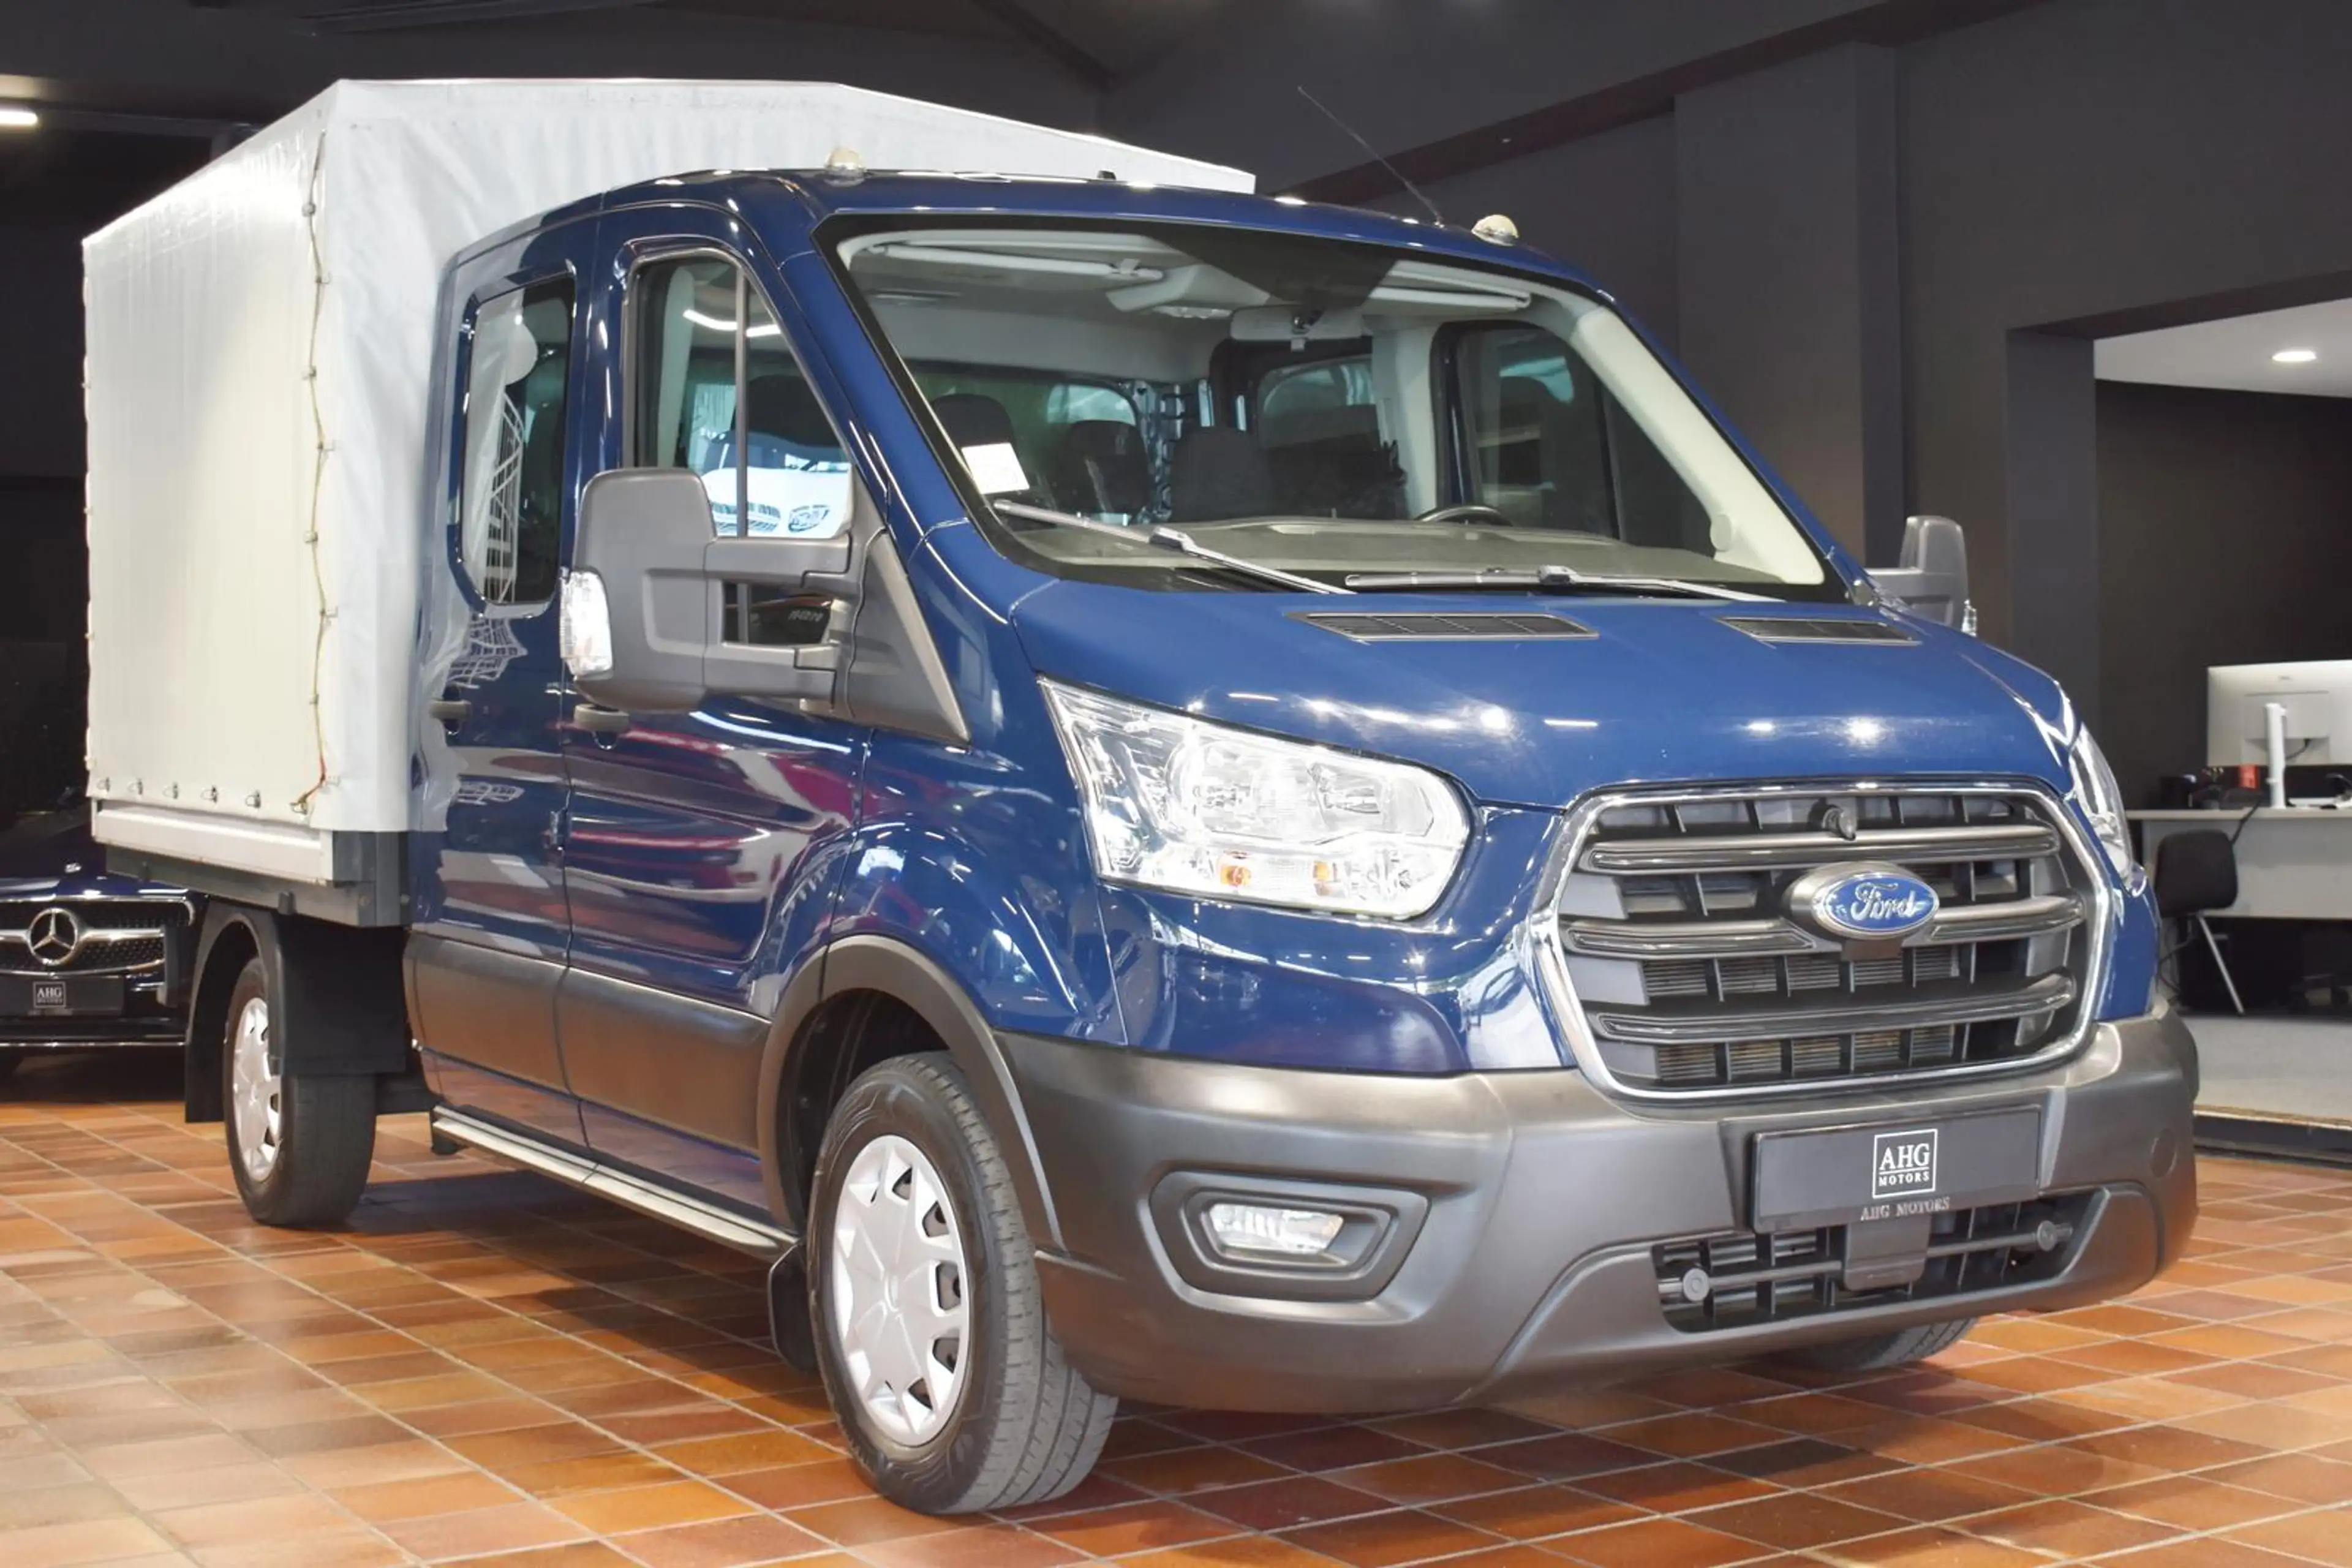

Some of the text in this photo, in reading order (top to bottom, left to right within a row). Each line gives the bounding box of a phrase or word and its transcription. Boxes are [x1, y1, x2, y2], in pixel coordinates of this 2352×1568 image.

[1850, 882, 1927, 921] Ford
[1879, 1143, 1930, 1170] AHG
[1878, 1171, 1929, 1186] MOTORS
[1860, 1196, 1950, 1221] AHG MOTORS
